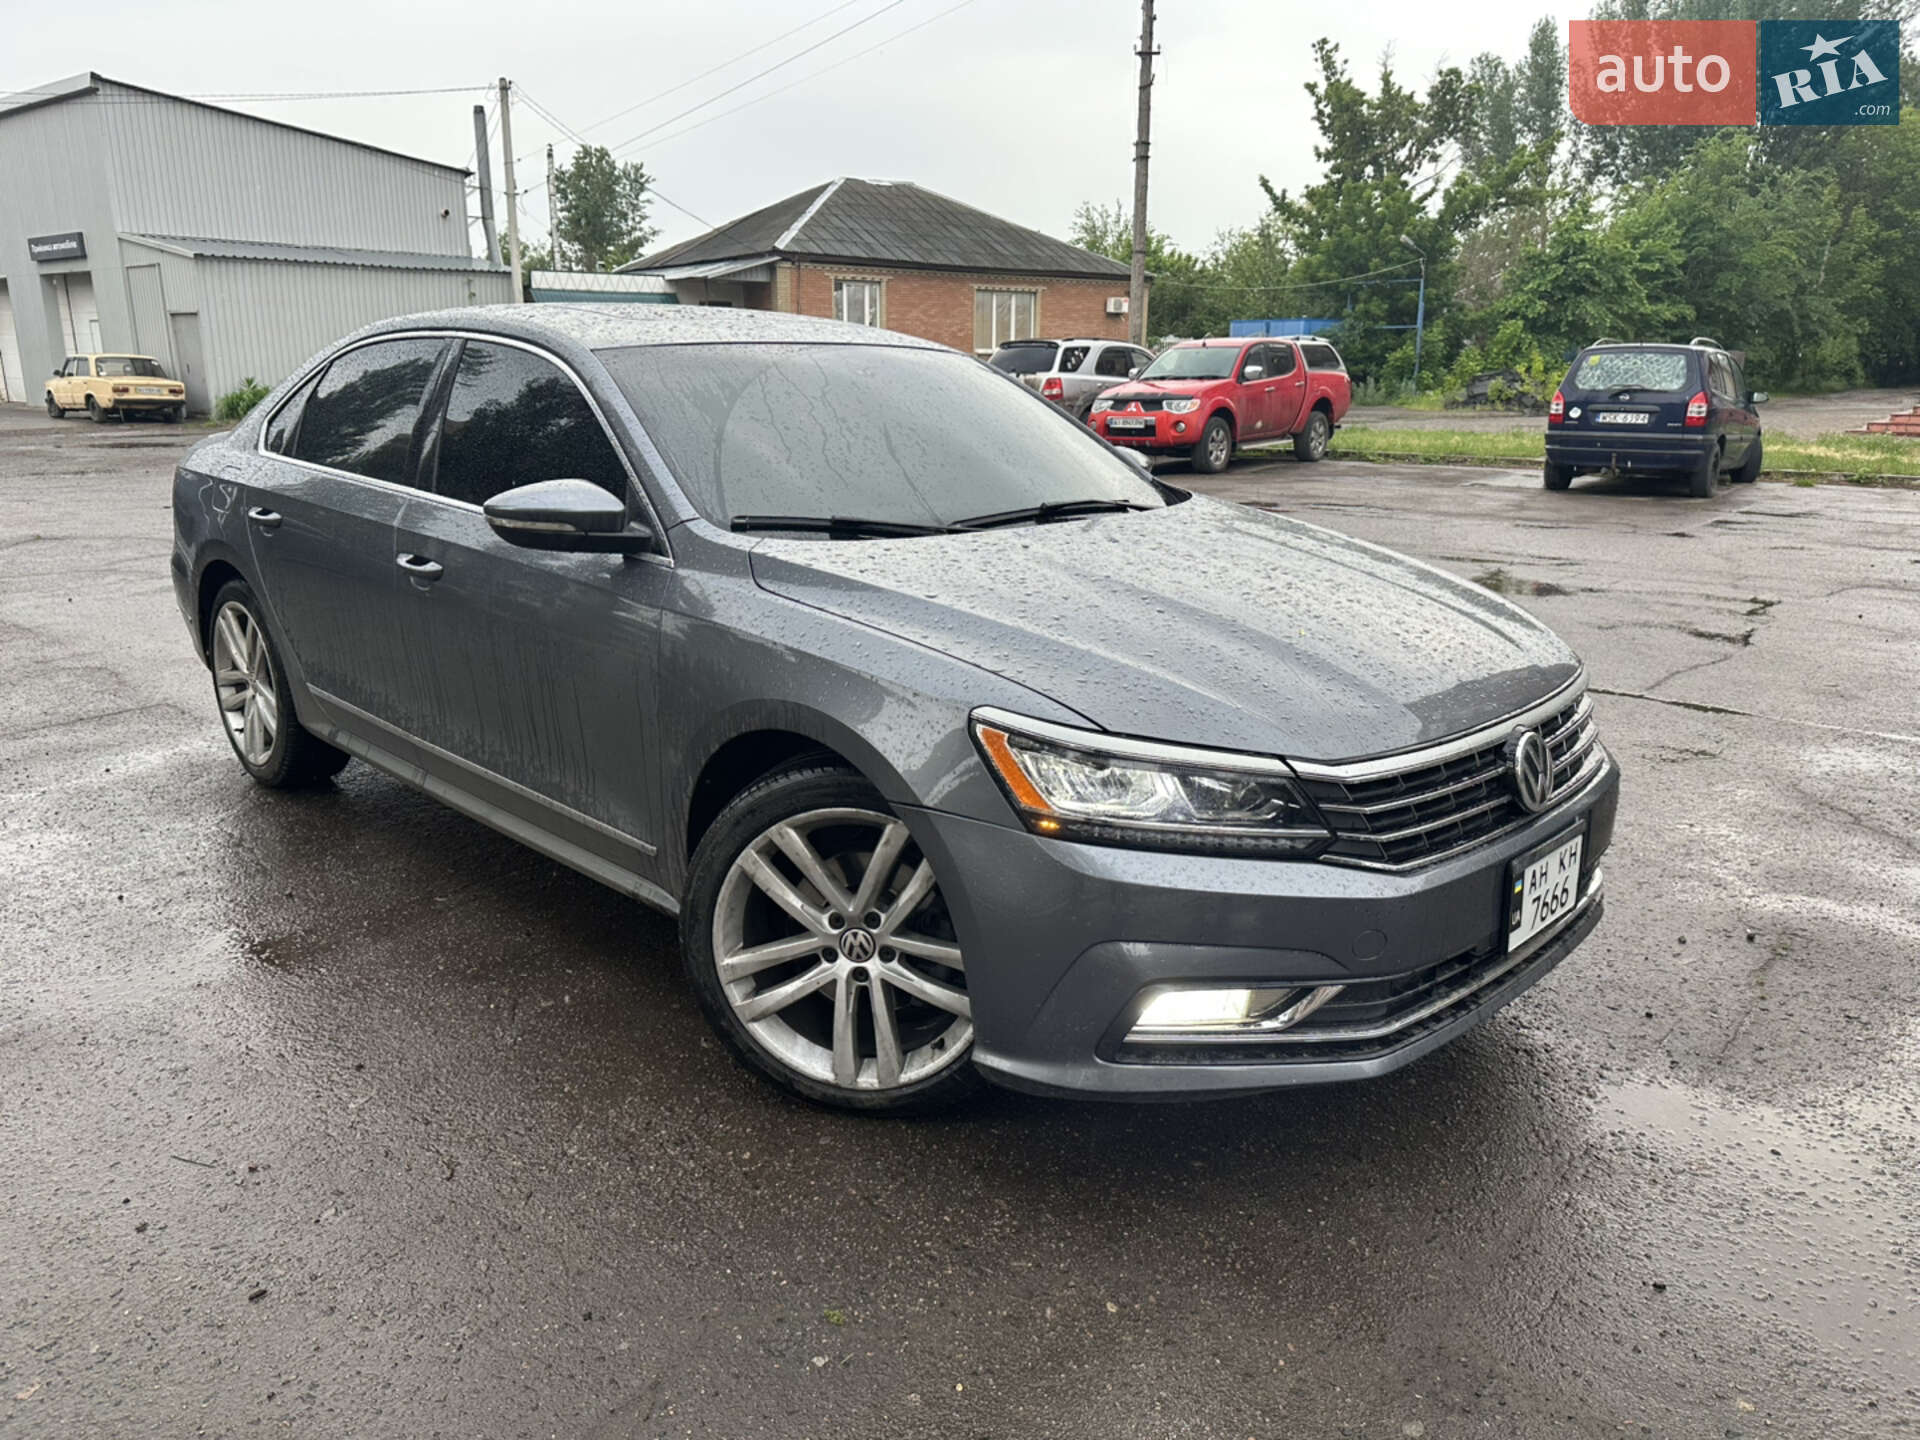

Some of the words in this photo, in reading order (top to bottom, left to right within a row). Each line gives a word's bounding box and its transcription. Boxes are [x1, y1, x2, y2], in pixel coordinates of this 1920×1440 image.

[1528, 861, 1549, 895] AH
[1558, 842, 1579, 874] KH
[1531, 875, 1570, 930] 7666
